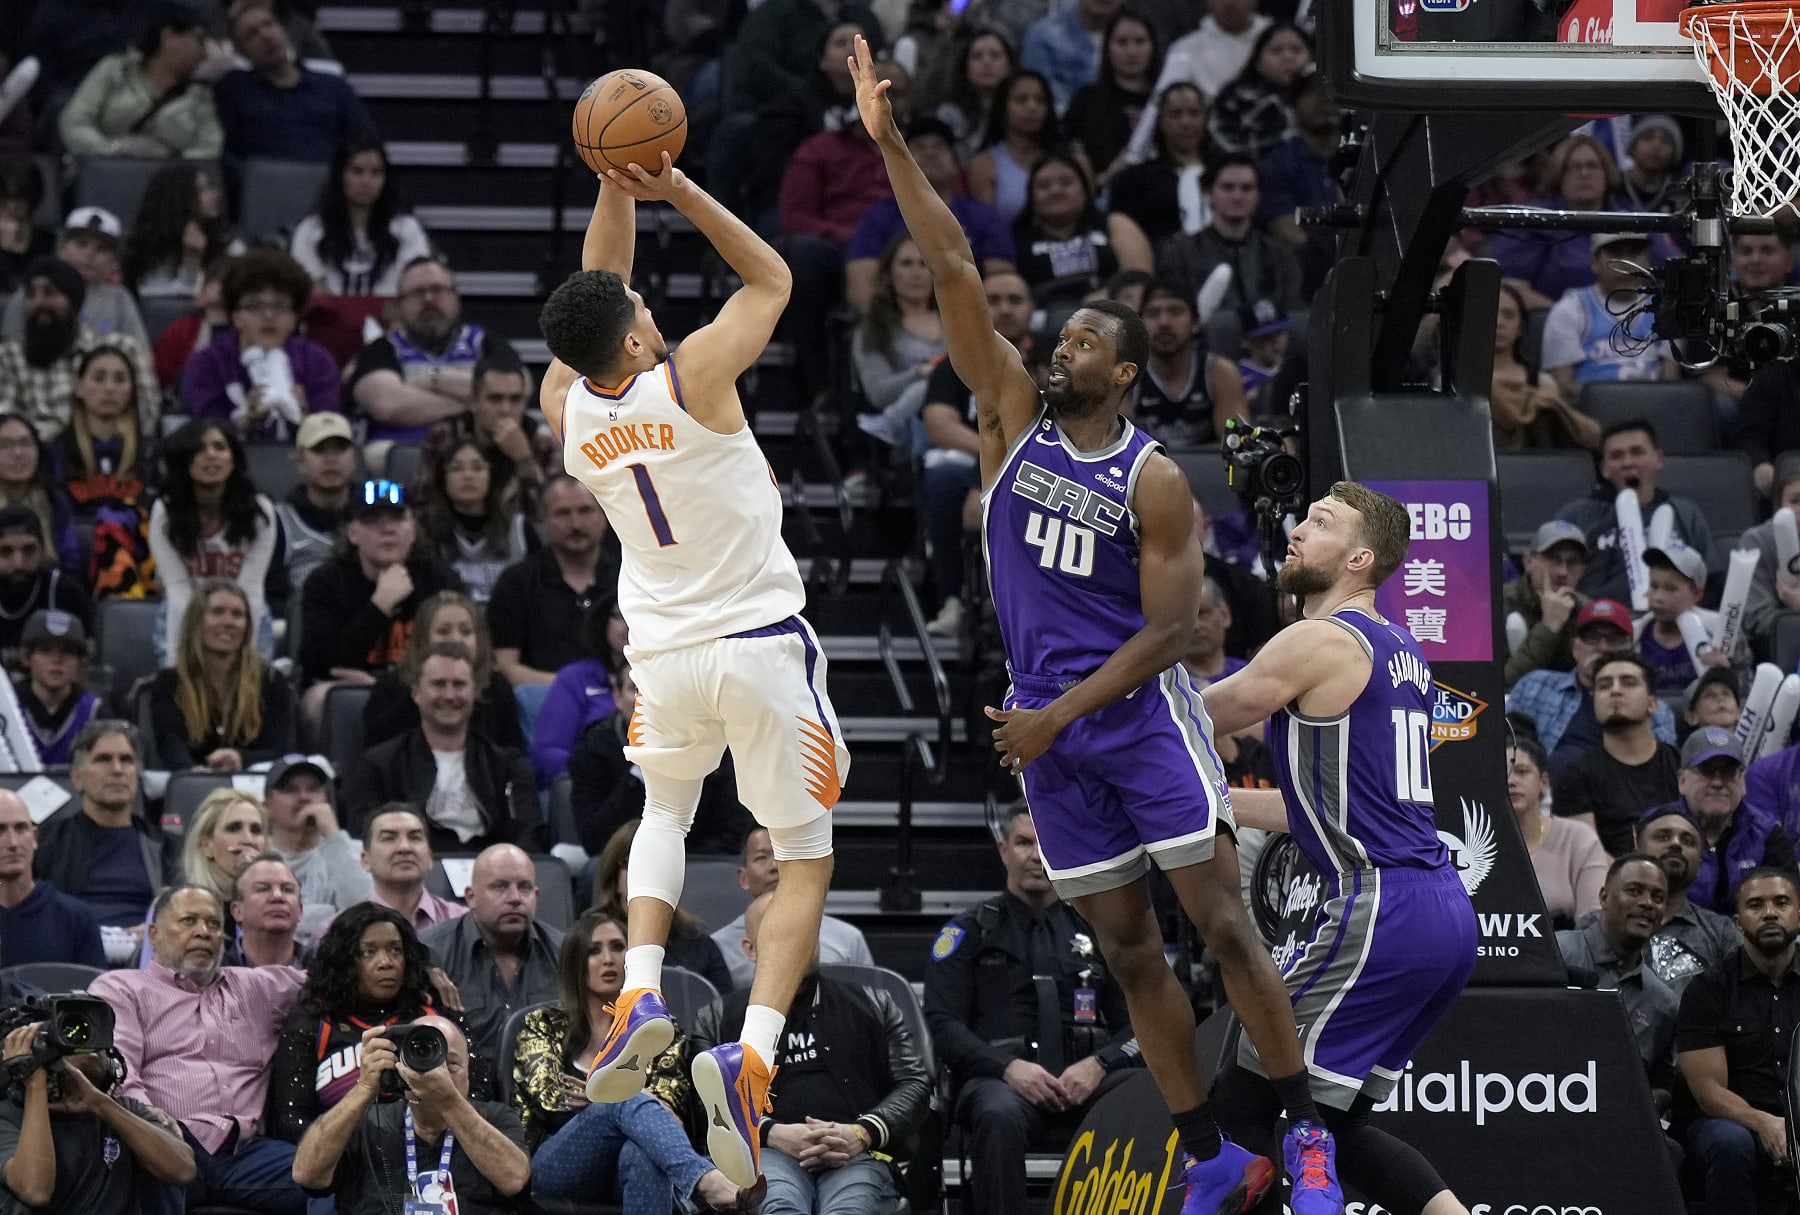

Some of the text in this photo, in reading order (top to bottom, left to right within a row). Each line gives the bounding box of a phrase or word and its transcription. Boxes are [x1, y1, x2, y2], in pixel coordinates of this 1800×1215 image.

[580, 423, 676, 470] BOOKER
[624, 462, 680, 549] 1
[1011, 459, 1126, 537] SAC
[1094, 473, 1127, 493] dialpad
[1025, 510, 1096, 578] 40
[1401, 502, 1472, 541] EBO
[1388, 650, 1431, 695] SABONIS
[1391, 707, 1434, 805] 10
